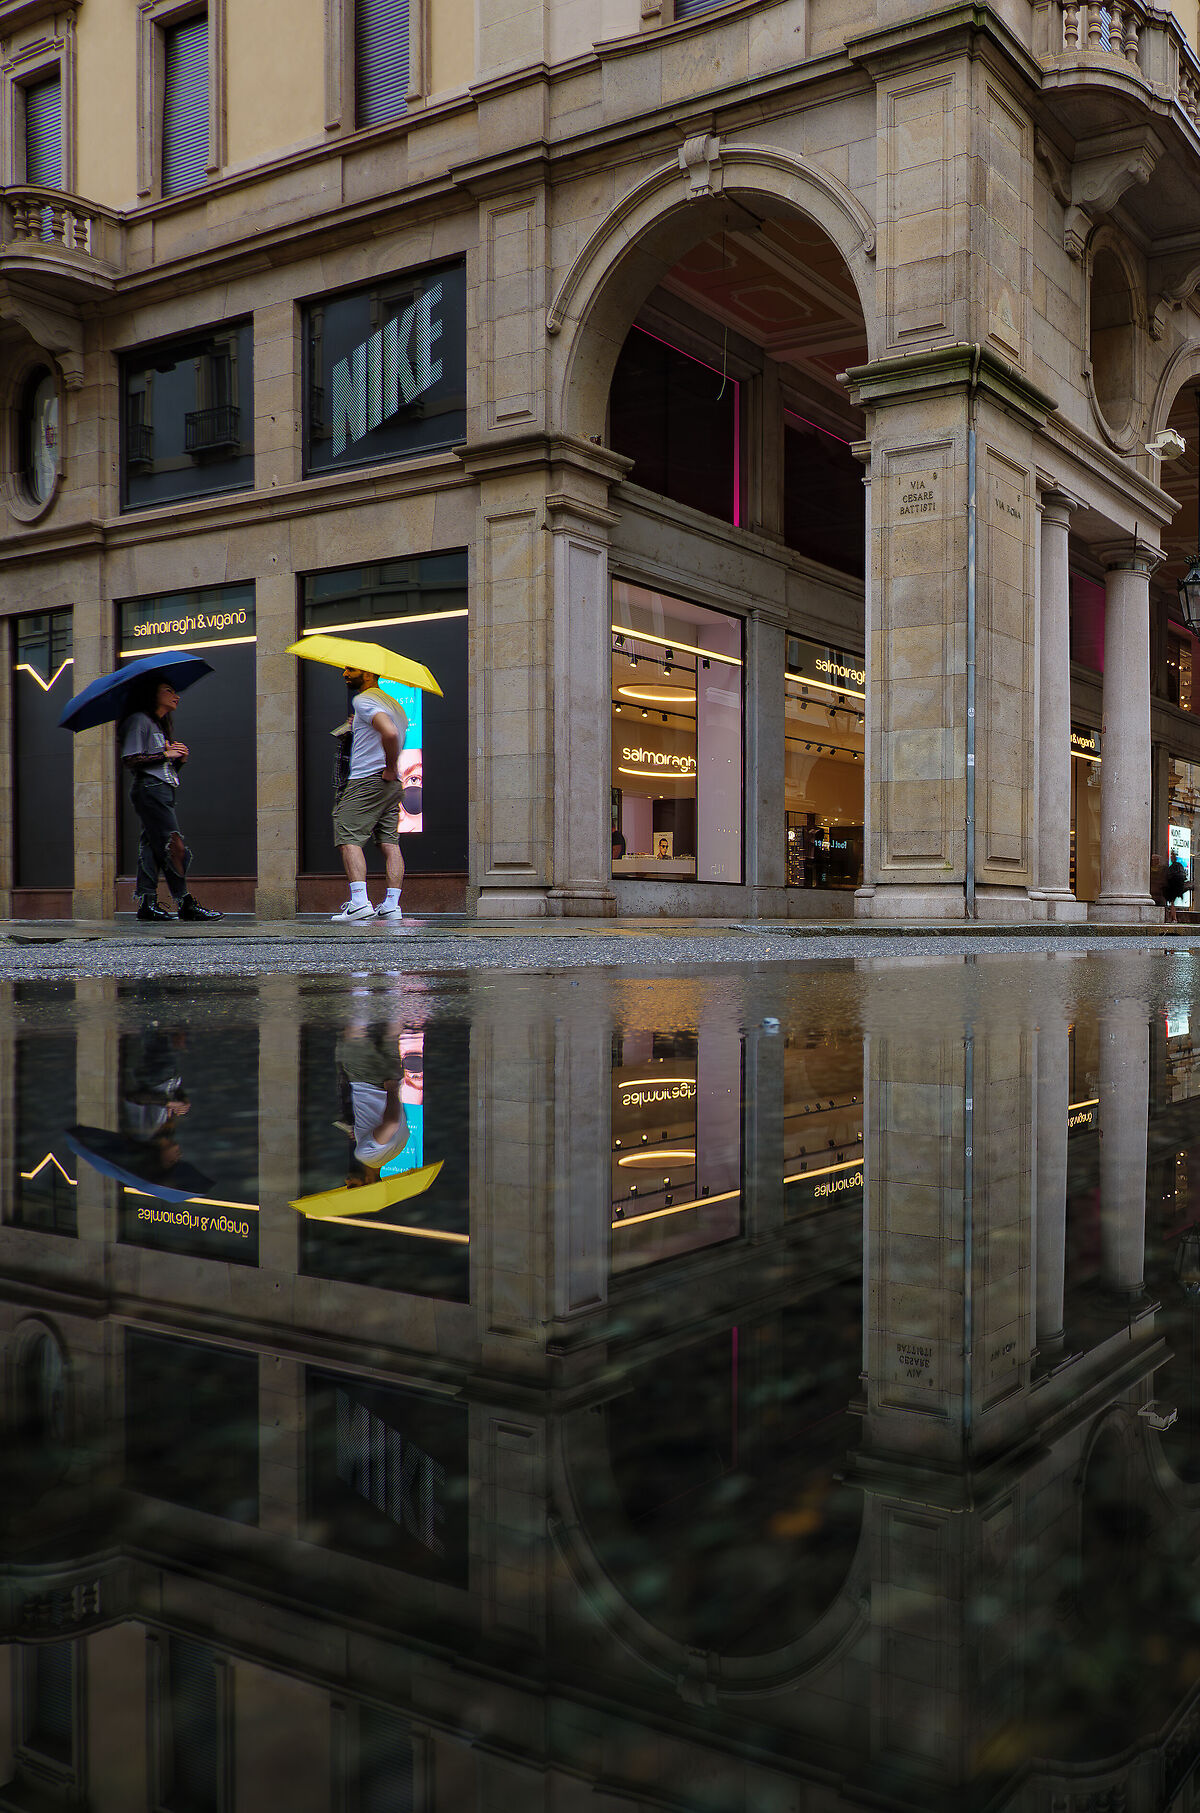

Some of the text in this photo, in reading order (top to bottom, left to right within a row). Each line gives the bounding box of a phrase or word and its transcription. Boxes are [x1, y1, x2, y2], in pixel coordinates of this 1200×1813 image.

[333, 281, 443, 458] NIKE
[911, 481, 925, 489] VIA
[903, 491, 934, 503] CESARE
[900, 503, 936, 514] BATTISTI
[996, 499, 1005, 510] VIA
[134, 616, 196, 637] salmoiraghi
[197, 613, 206, 629] &
[1072, 733, 1077, 744] &
